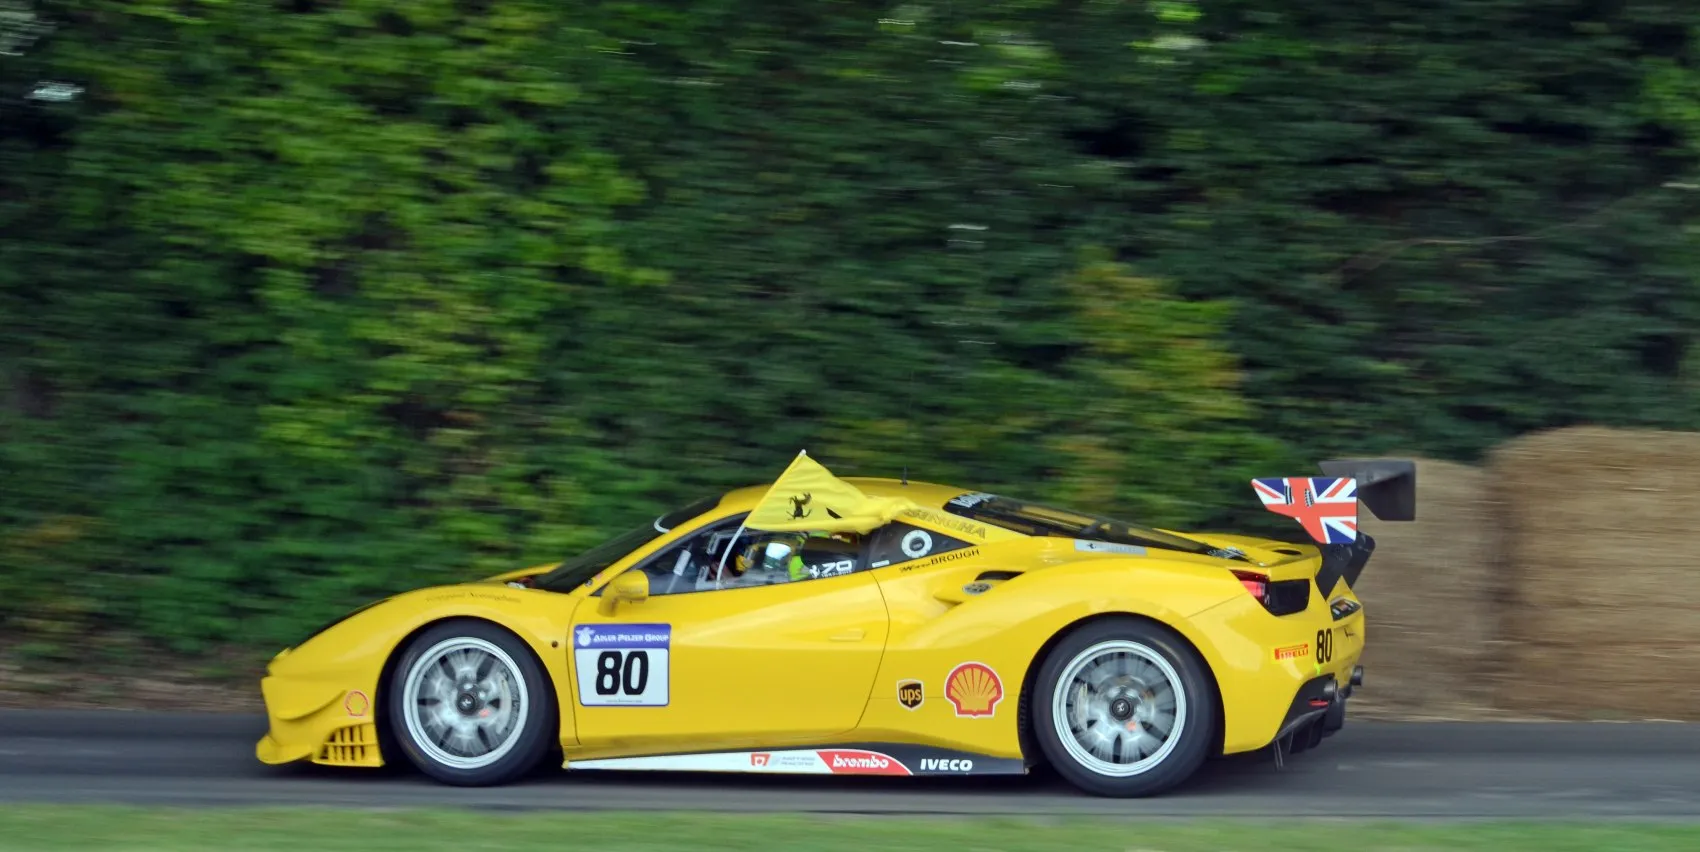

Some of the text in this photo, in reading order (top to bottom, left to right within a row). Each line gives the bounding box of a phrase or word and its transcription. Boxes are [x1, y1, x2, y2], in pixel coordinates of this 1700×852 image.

[930, 548, 981, 565] BROUGH
[821, 560, 853, 574] 70
[1274, 643, 1309, 660] PIRELLI
[1316, 628, 1333, 664] 80
[596, 651, 649, 696] 80
[832, 754, 889, 769] brembo
[920, 758, 973, 772] IVECO
